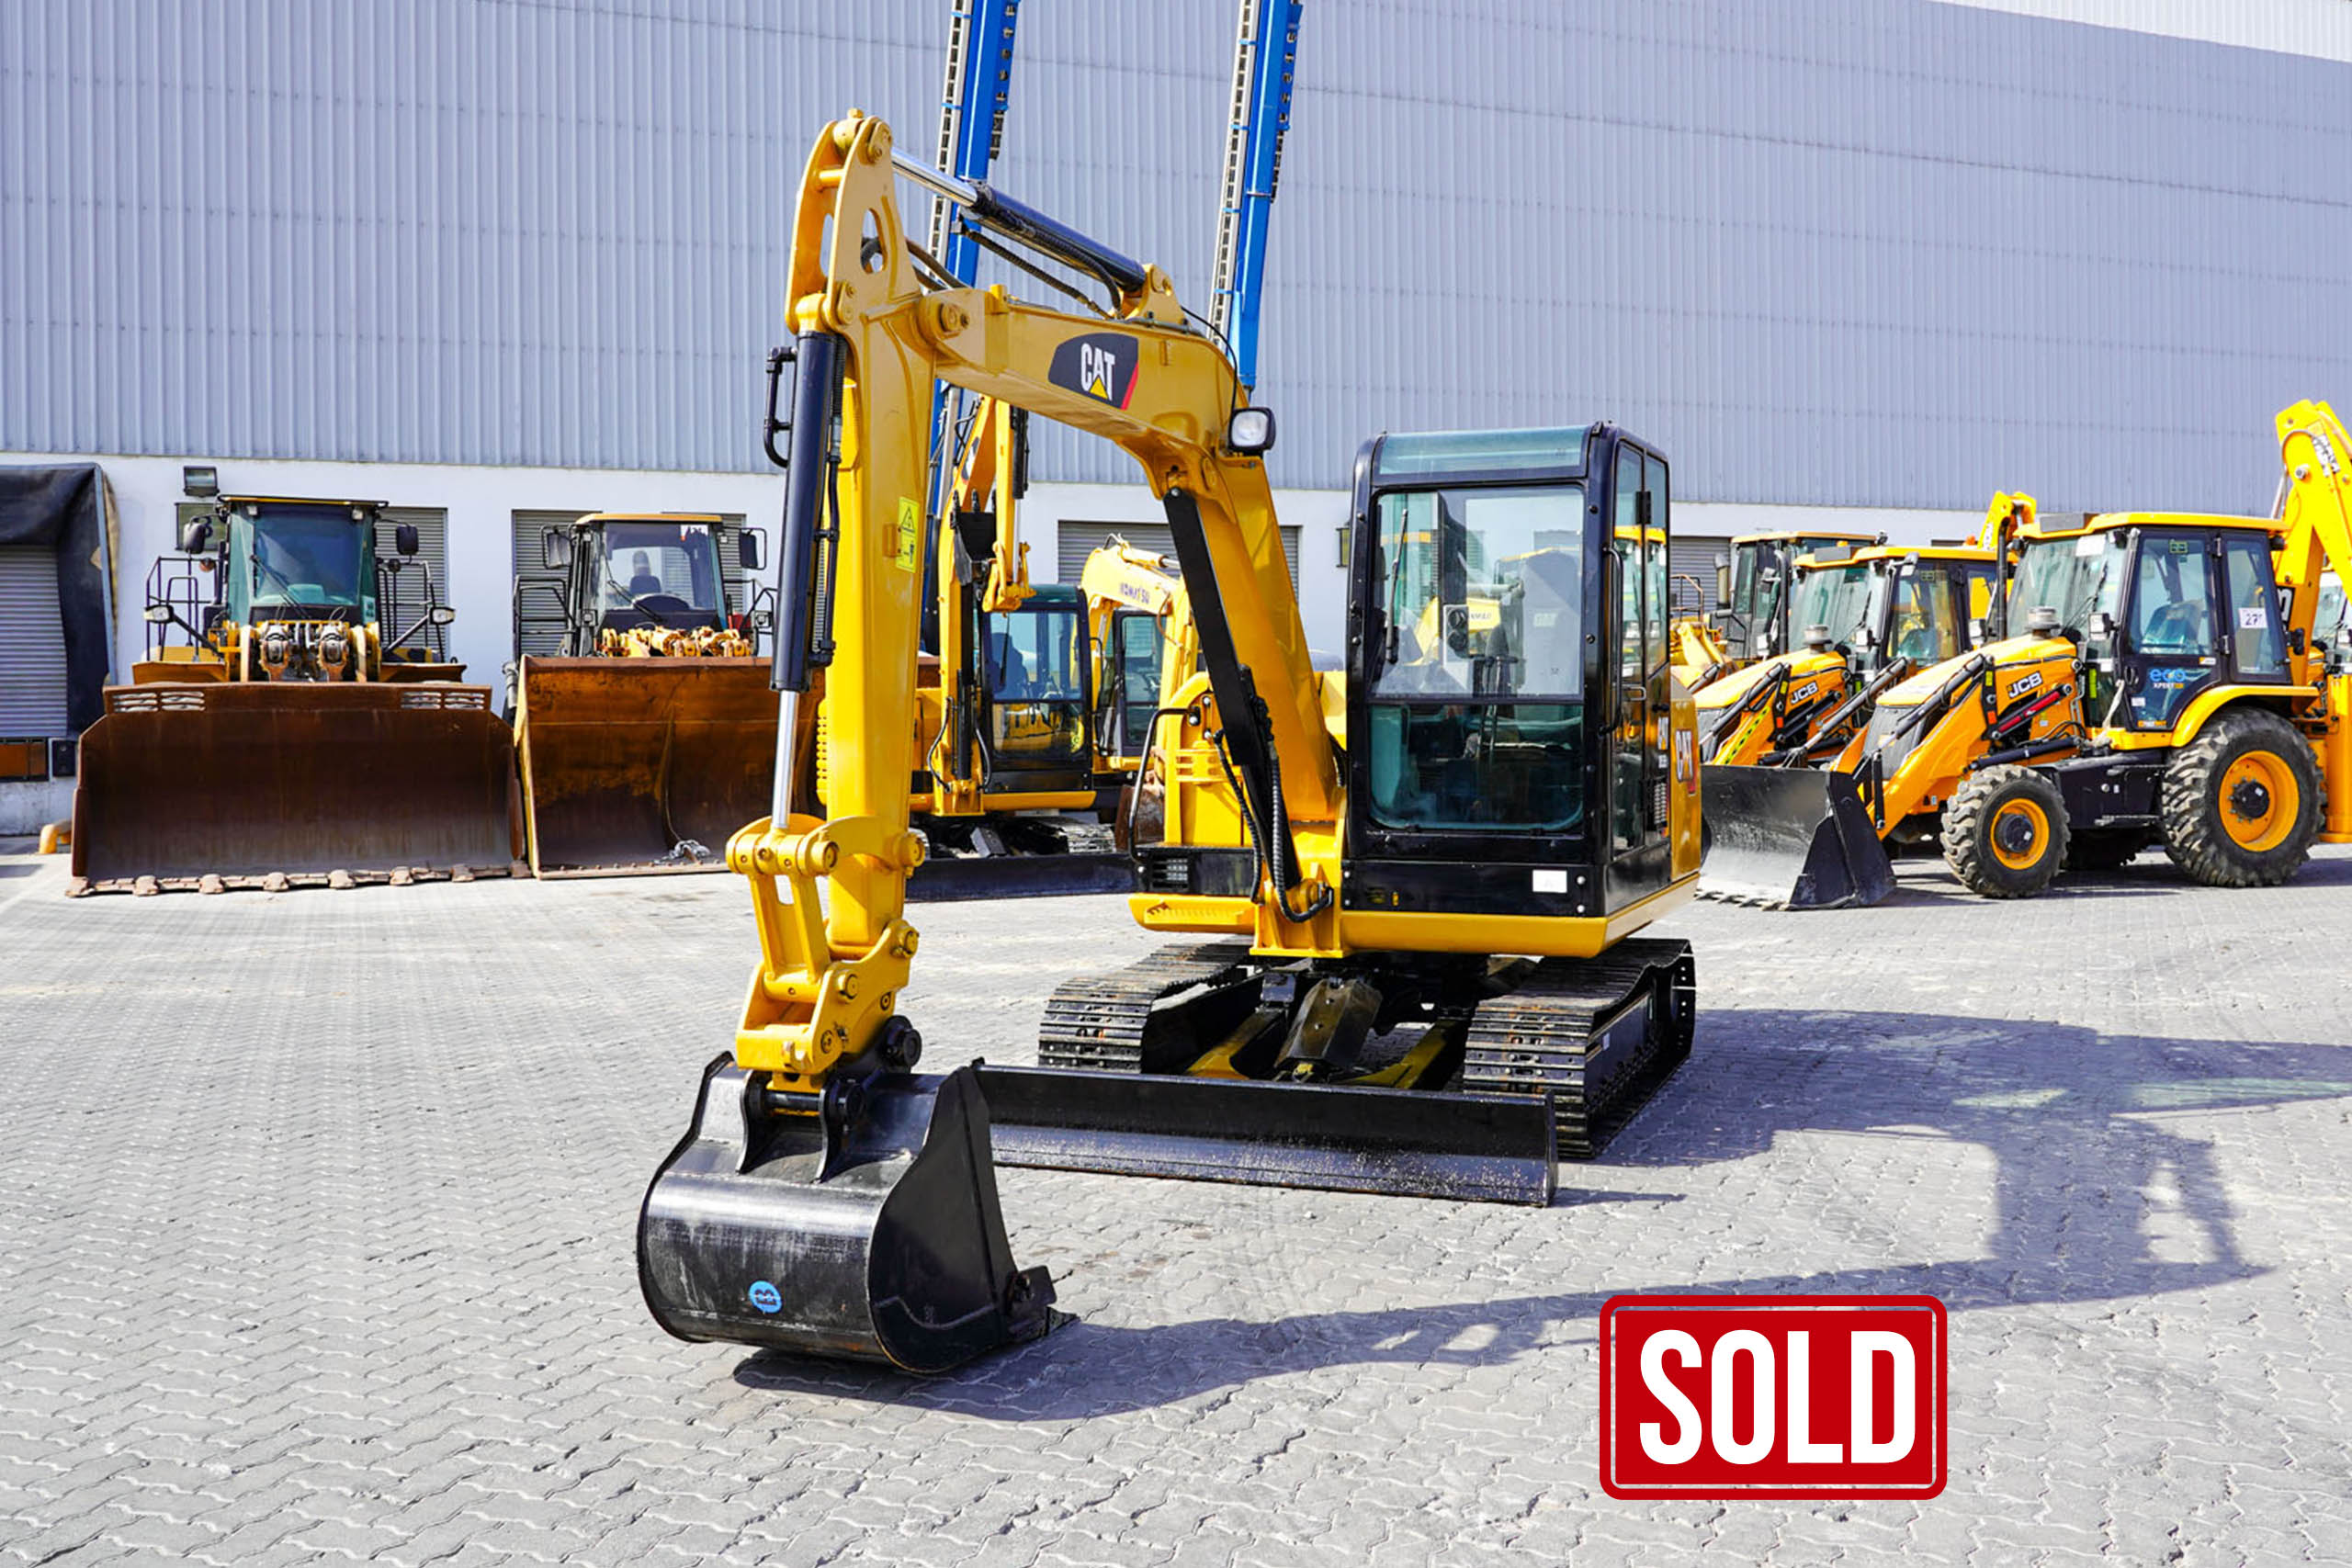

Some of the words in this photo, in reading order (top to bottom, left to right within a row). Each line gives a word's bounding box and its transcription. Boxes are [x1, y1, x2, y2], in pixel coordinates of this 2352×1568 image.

[1080, 342, 1115, 400] CAT
[2008, 671, 2042, 698] JCB
[2150, 669, 2186, 682] eco
[1791, 682, 1818, 704] JCB
[1675, 729, 1693, 781] CAT
